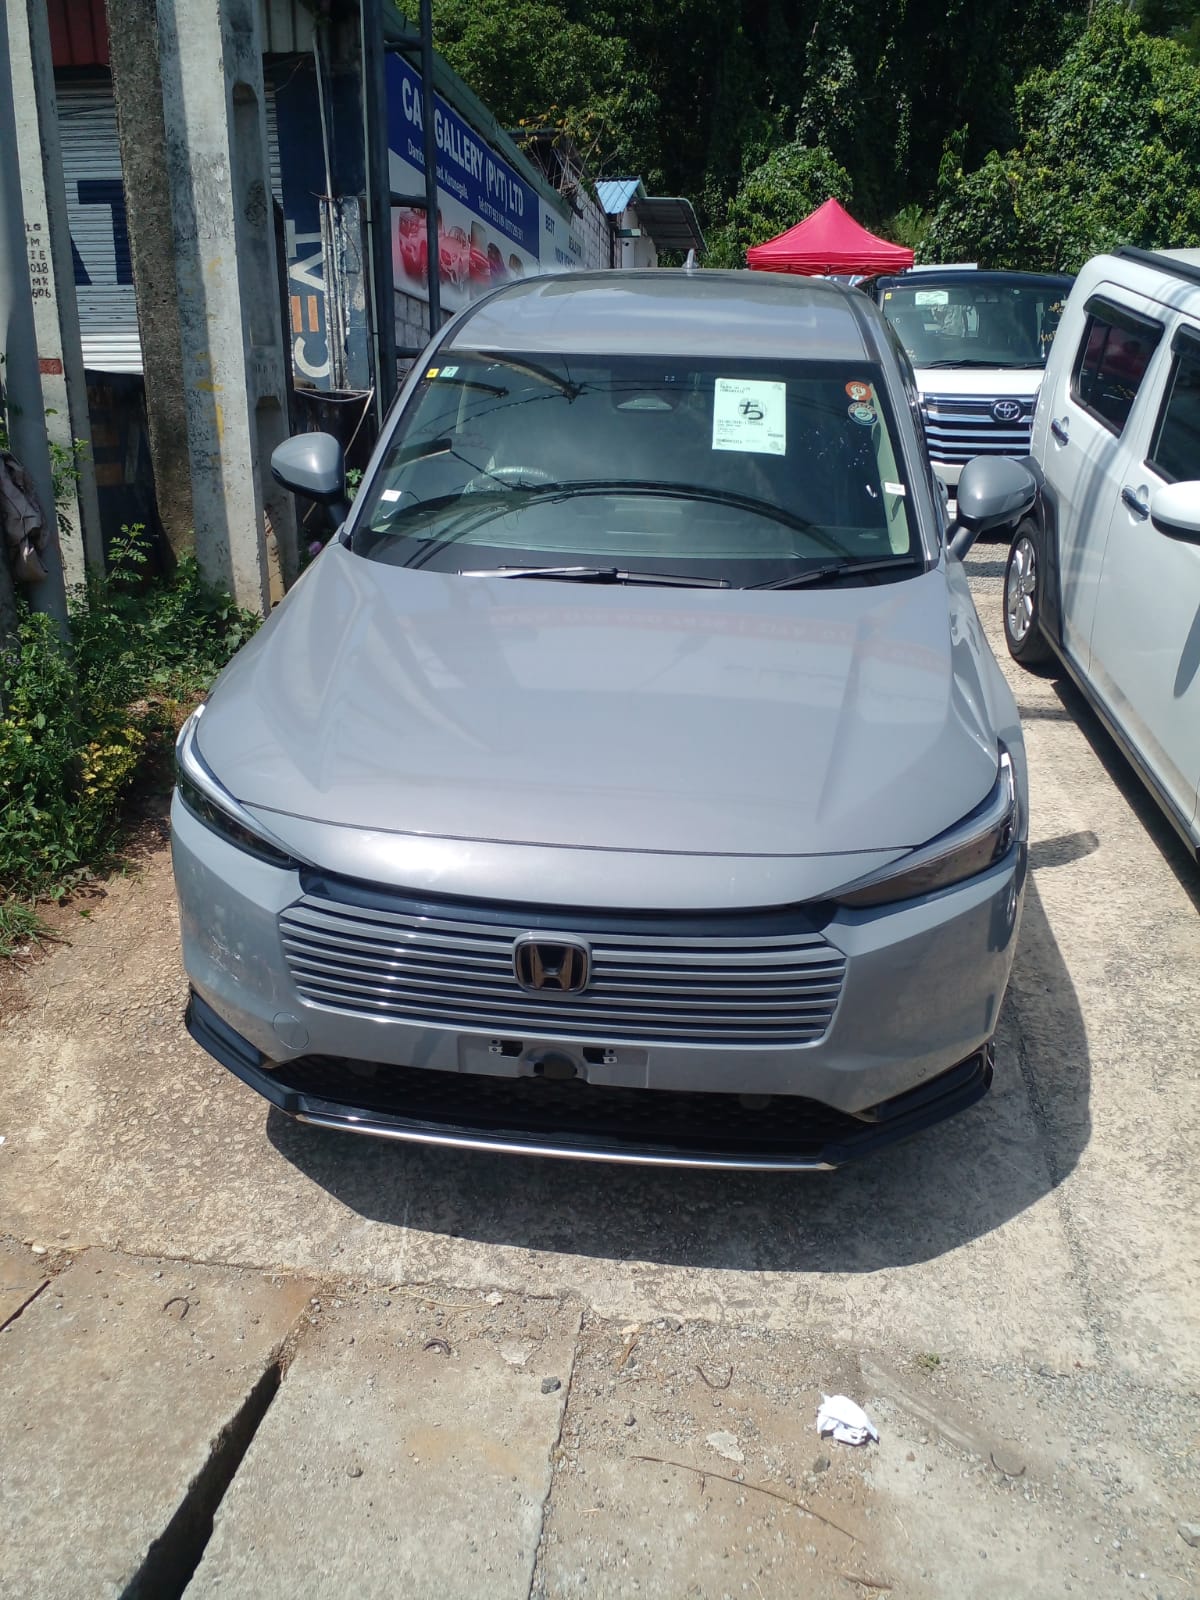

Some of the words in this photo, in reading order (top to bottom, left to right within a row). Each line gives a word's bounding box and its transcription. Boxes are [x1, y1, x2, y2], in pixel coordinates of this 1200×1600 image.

[402, 77, 424, 132] CA
[434, 108, 483, 183] GALLERY
[486, 157, 508, 213] (PVT)
[509, 179, 524, 217] LTD
[26, 223, 41, 232] LG
[30, 237, 40, 247] M
[30, 263, 49, 274] 018
